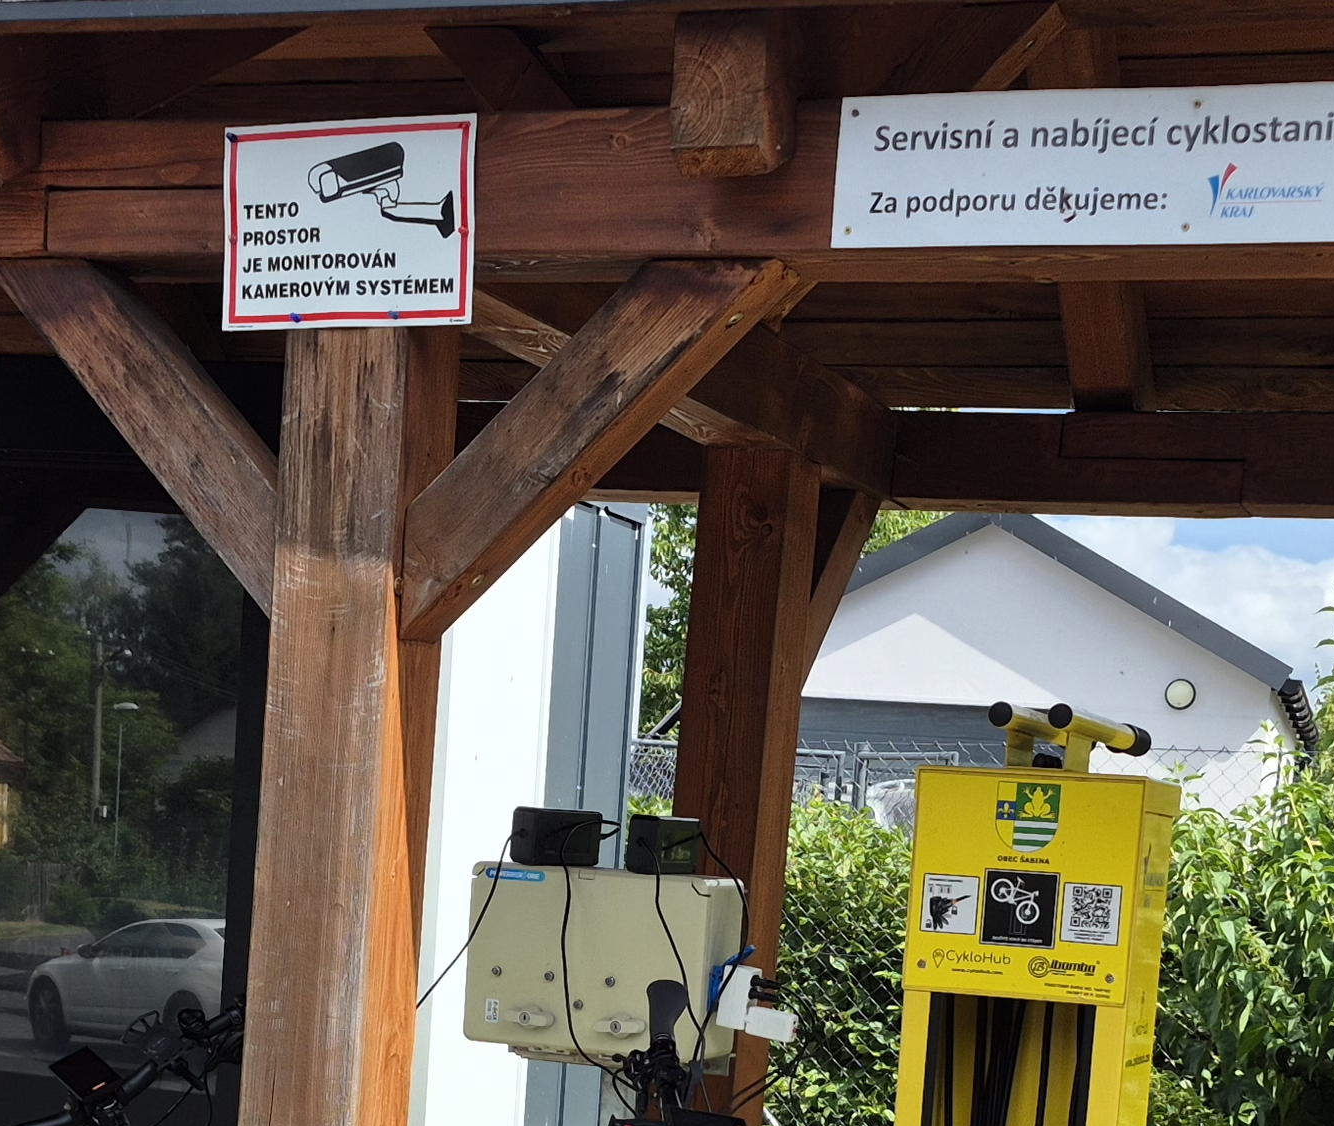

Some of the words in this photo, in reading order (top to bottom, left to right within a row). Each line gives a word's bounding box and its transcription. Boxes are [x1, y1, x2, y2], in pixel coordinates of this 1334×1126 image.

[873, 119, 996, 152] Servisní
[1001, 125, 1019, 149] a
[1030, 117, 1159, 154] nabíjecí
[1224, 182, 1326, 201] KARLOVARSKÝ
[243, 202, 299, 219] TENTO
[868, 190, 898, 214] Za
[905, 188, 1016, 218] podporu
[1024, 186, 1168, 216] děkujeme:
[1219, 205, 1254, 219] KRAJ
[243, 228, 320, 246] PROSTOR
[242, 257, 262, 273] JE
[267, 249, 396, 272] MONITOROVÁN
[242, 276, 350, 299] KAMEROVÝM
[356, 275, 454, 295] SYSTÉMEM
[997, 855, 1018, 863] OBEC
[946, 949, 1011, 965] CykloHub
